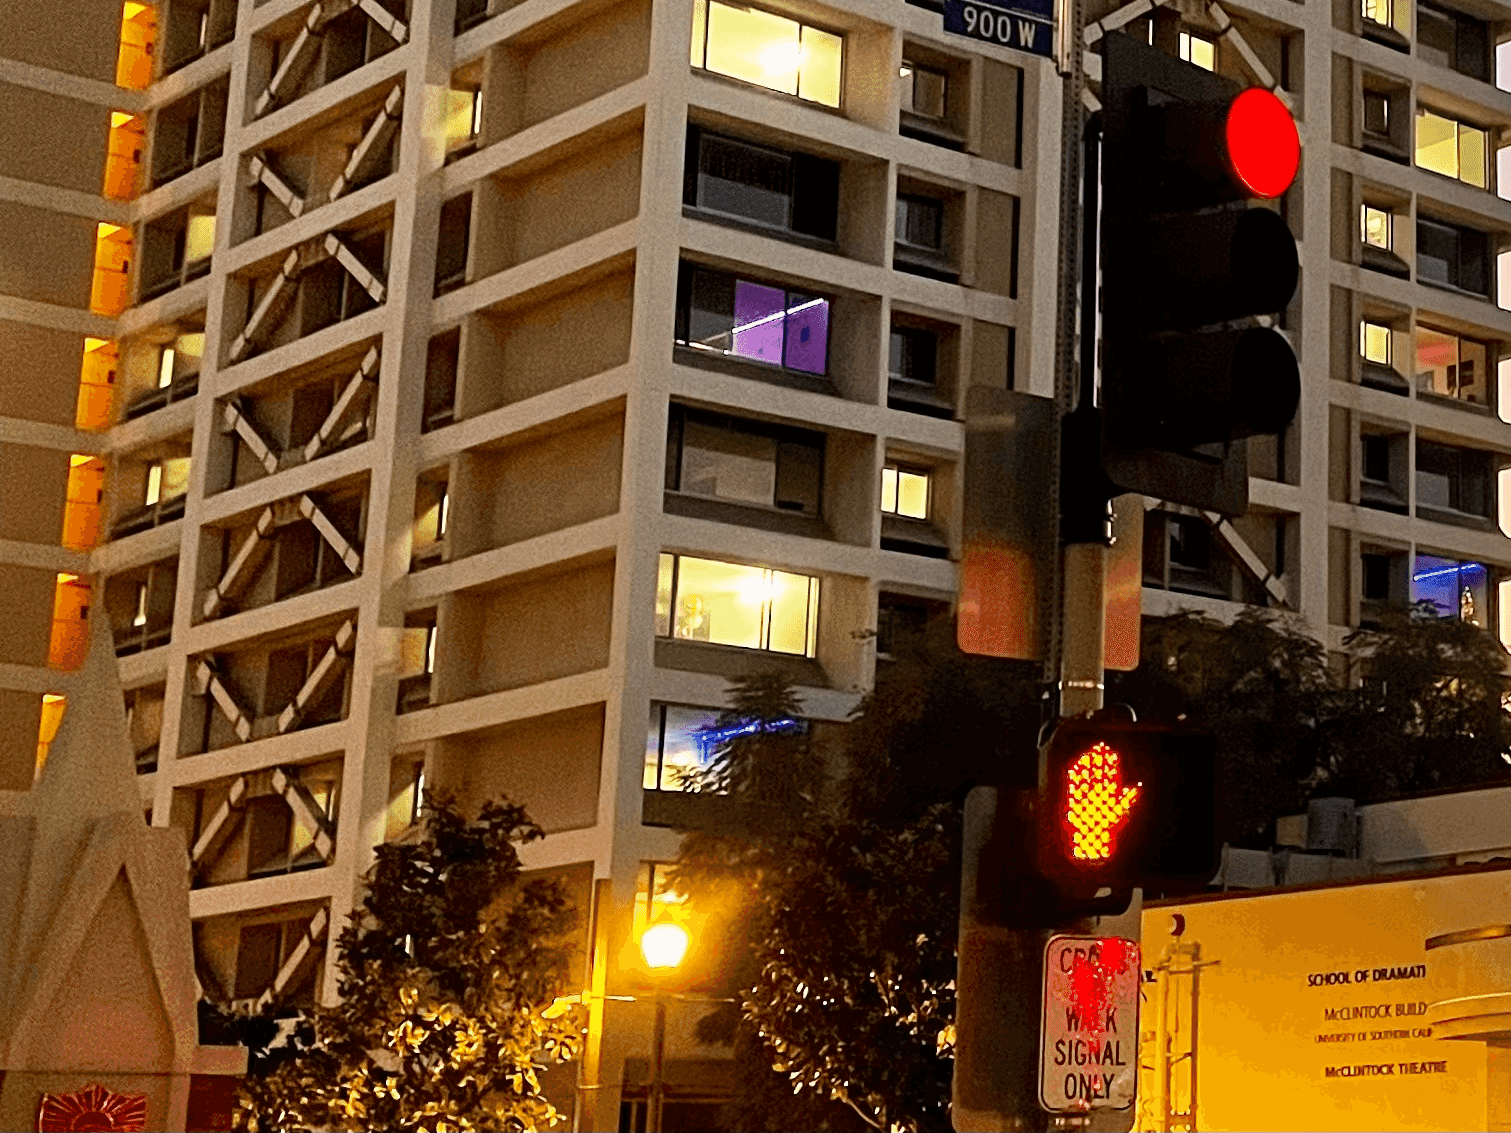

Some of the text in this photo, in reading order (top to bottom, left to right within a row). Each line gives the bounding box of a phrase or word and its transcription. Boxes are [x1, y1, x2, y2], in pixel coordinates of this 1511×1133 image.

[963, 6, 1036, 49] 900 W
[1308, 972, 1351, 987] SCHOOL
[1354, 970, 1369, 983] OF
[1054, 1038, 1126, 1066] SIGNAL
[1398, 1060, 1447, 1074] THEATRE
[1064, 1072, 1114, 1100] ONLY
